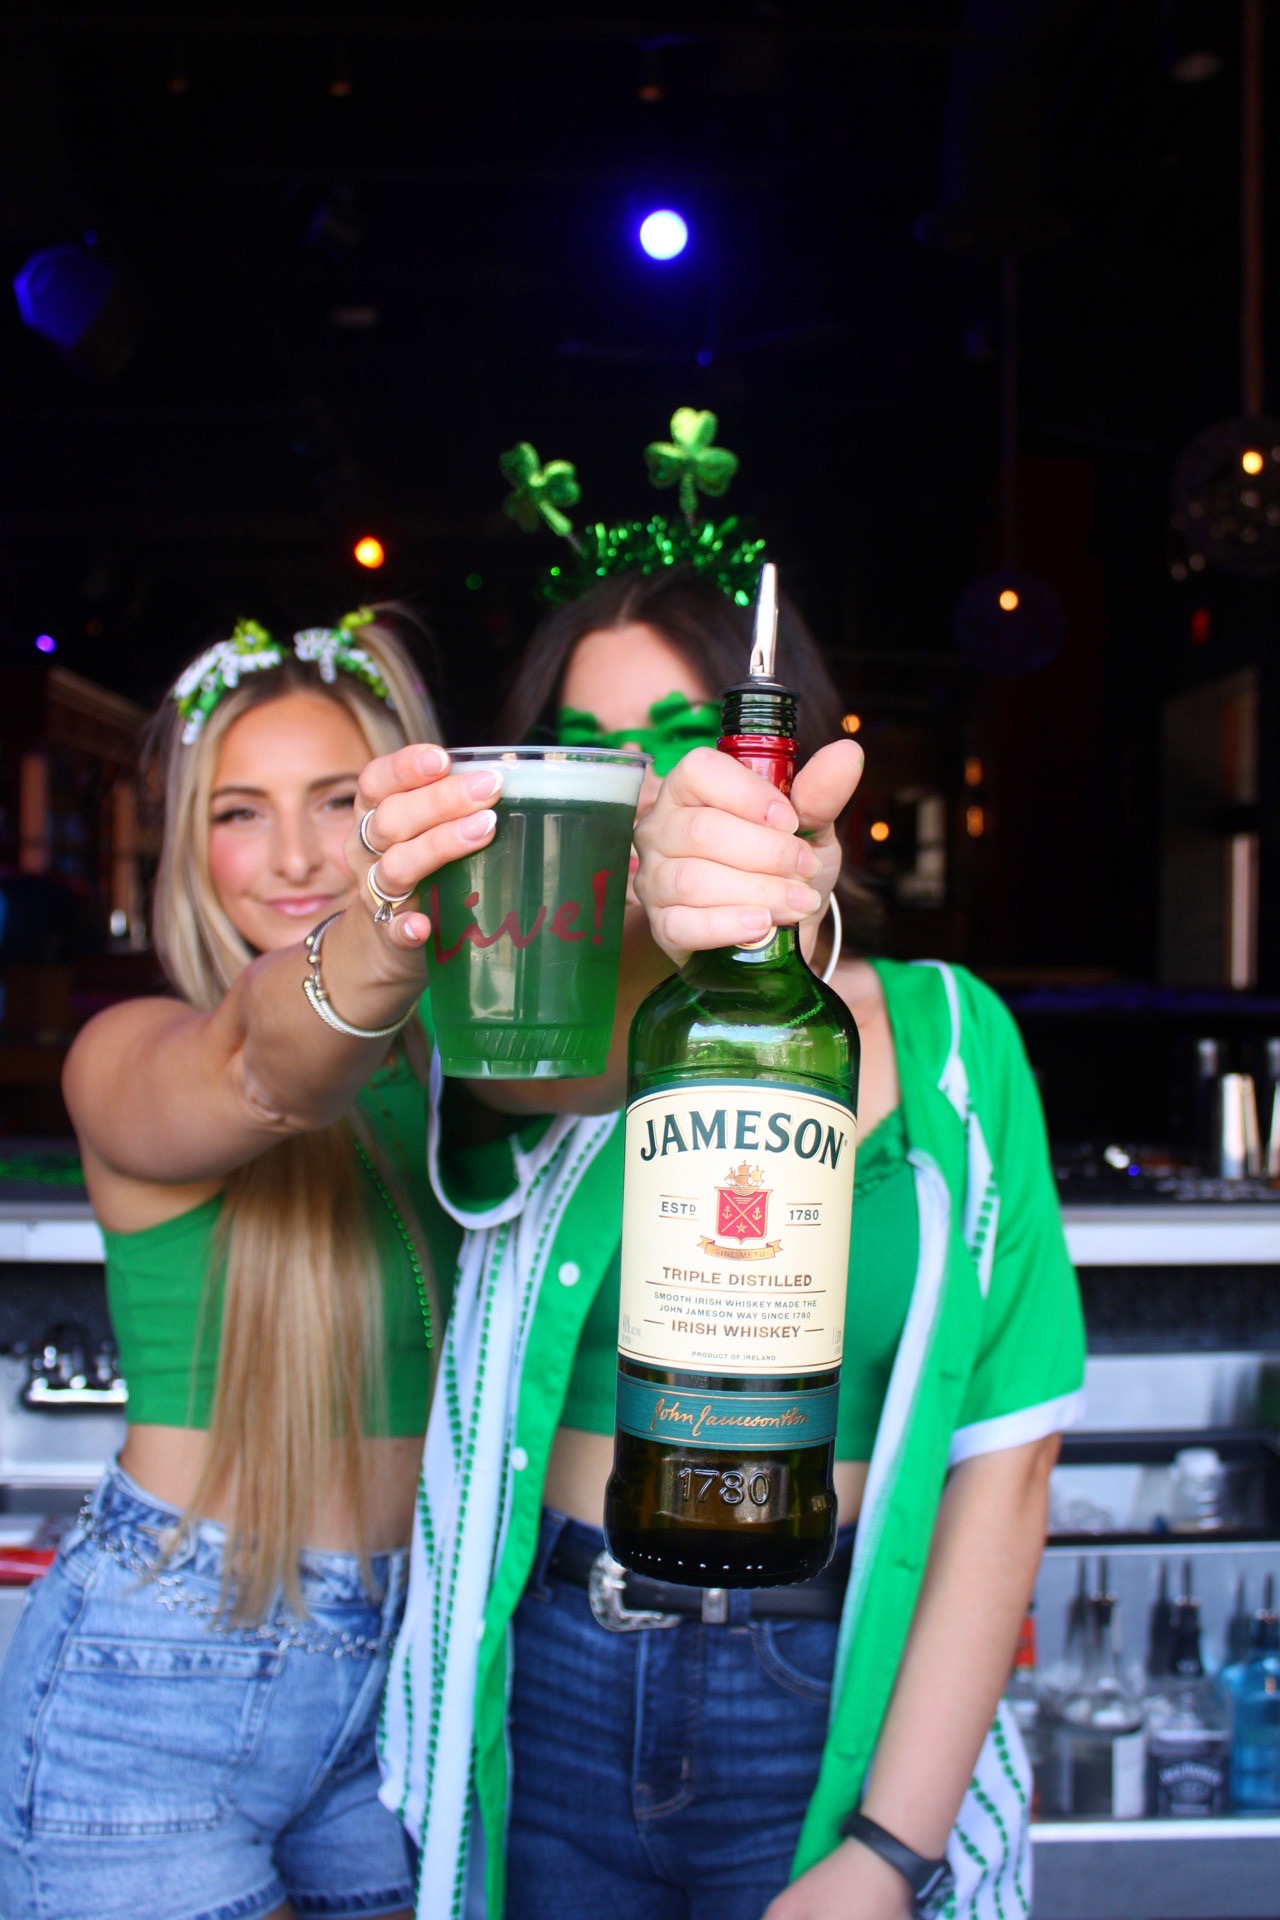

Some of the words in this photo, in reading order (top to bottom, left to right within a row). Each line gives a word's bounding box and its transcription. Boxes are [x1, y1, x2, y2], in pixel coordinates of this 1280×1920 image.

[429, 868, 609, 965] Live!
[640, 1109, 845, 1170] JAMESON
[661, 1201, 697, 1216] ESTD
[789, 1209, 820, 1221] 1780
[714, 1249, 736, 1258] SINE
[740, 1251, 766, 1259] METU
[662, 1266, 722, 1285] TRIPLE
[728, 1273, 812, 1287] DISTILLED
[654, 1291, 692, 1304] SMOOTH
[695, 1297, 722, 1307] IRISH
[725, 1299, 772, 1308] WHISKEY
[659, 1304, 683, 1314] JOHN
[685, 1307, 732, 1318] JAMESON
[736, 1312, 759, 1320] WAY
[761, 1312, 789, 1320] SINCE
[793, 1311, 811, 1319] 1780
[671, 1319, 717, 1336] IRISH
[723, 1325, 801, 1338] WHISKEY
[691, 1350, 728, 1360] PRODUCT
[651, 1398, 693, 1431] John
[678, 1466, 771, 1507] 1780
